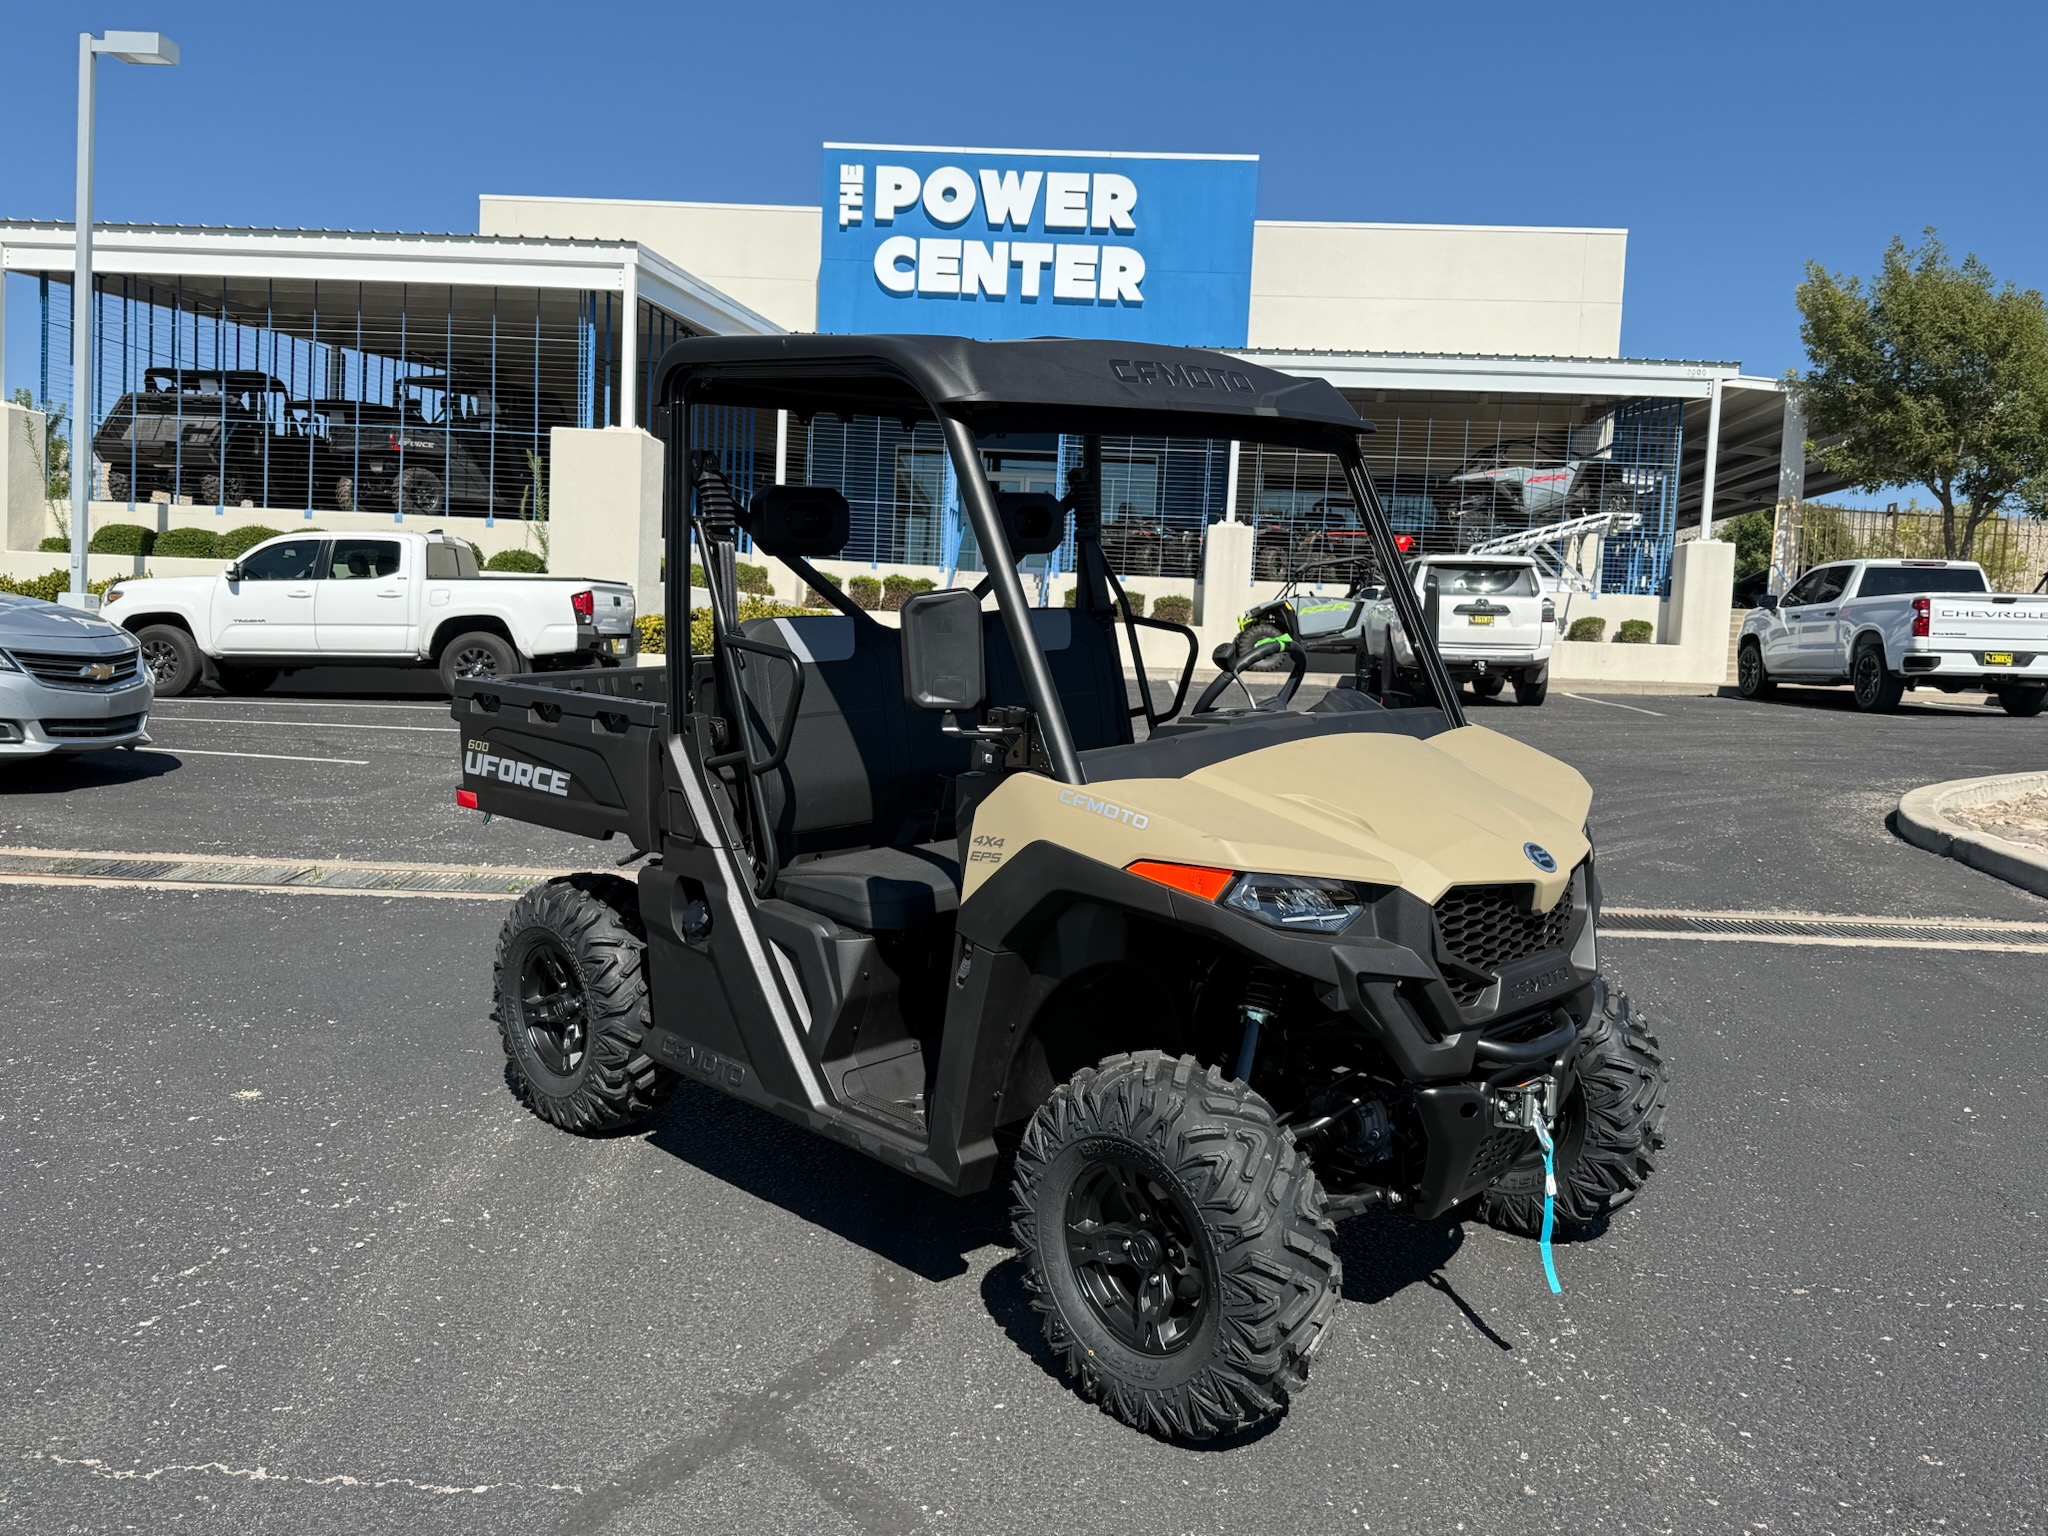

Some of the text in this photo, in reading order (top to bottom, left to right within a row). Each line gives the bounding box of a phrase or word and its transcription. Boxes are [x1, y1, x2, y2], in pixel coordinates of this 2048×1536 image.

[839, 164, 864, 226] THE
[874, 165, 1138, 230] POWER
[873, 235, 1146, 302] CENTER
[1109, 358, 1256, 394] CFMOTO
[467, 739, 489, 752] 600
[464, 751, 572, 797] UFORCE
[1059, 789, 1150, 830] CFMOTO
[969, 851, 1003, 863] EPS
[972, 835, 1005, 849] 4X4
[1510, 966, 1569, 999] CFMOTO
[662, 1034, 746, 1087] CFMOTO
